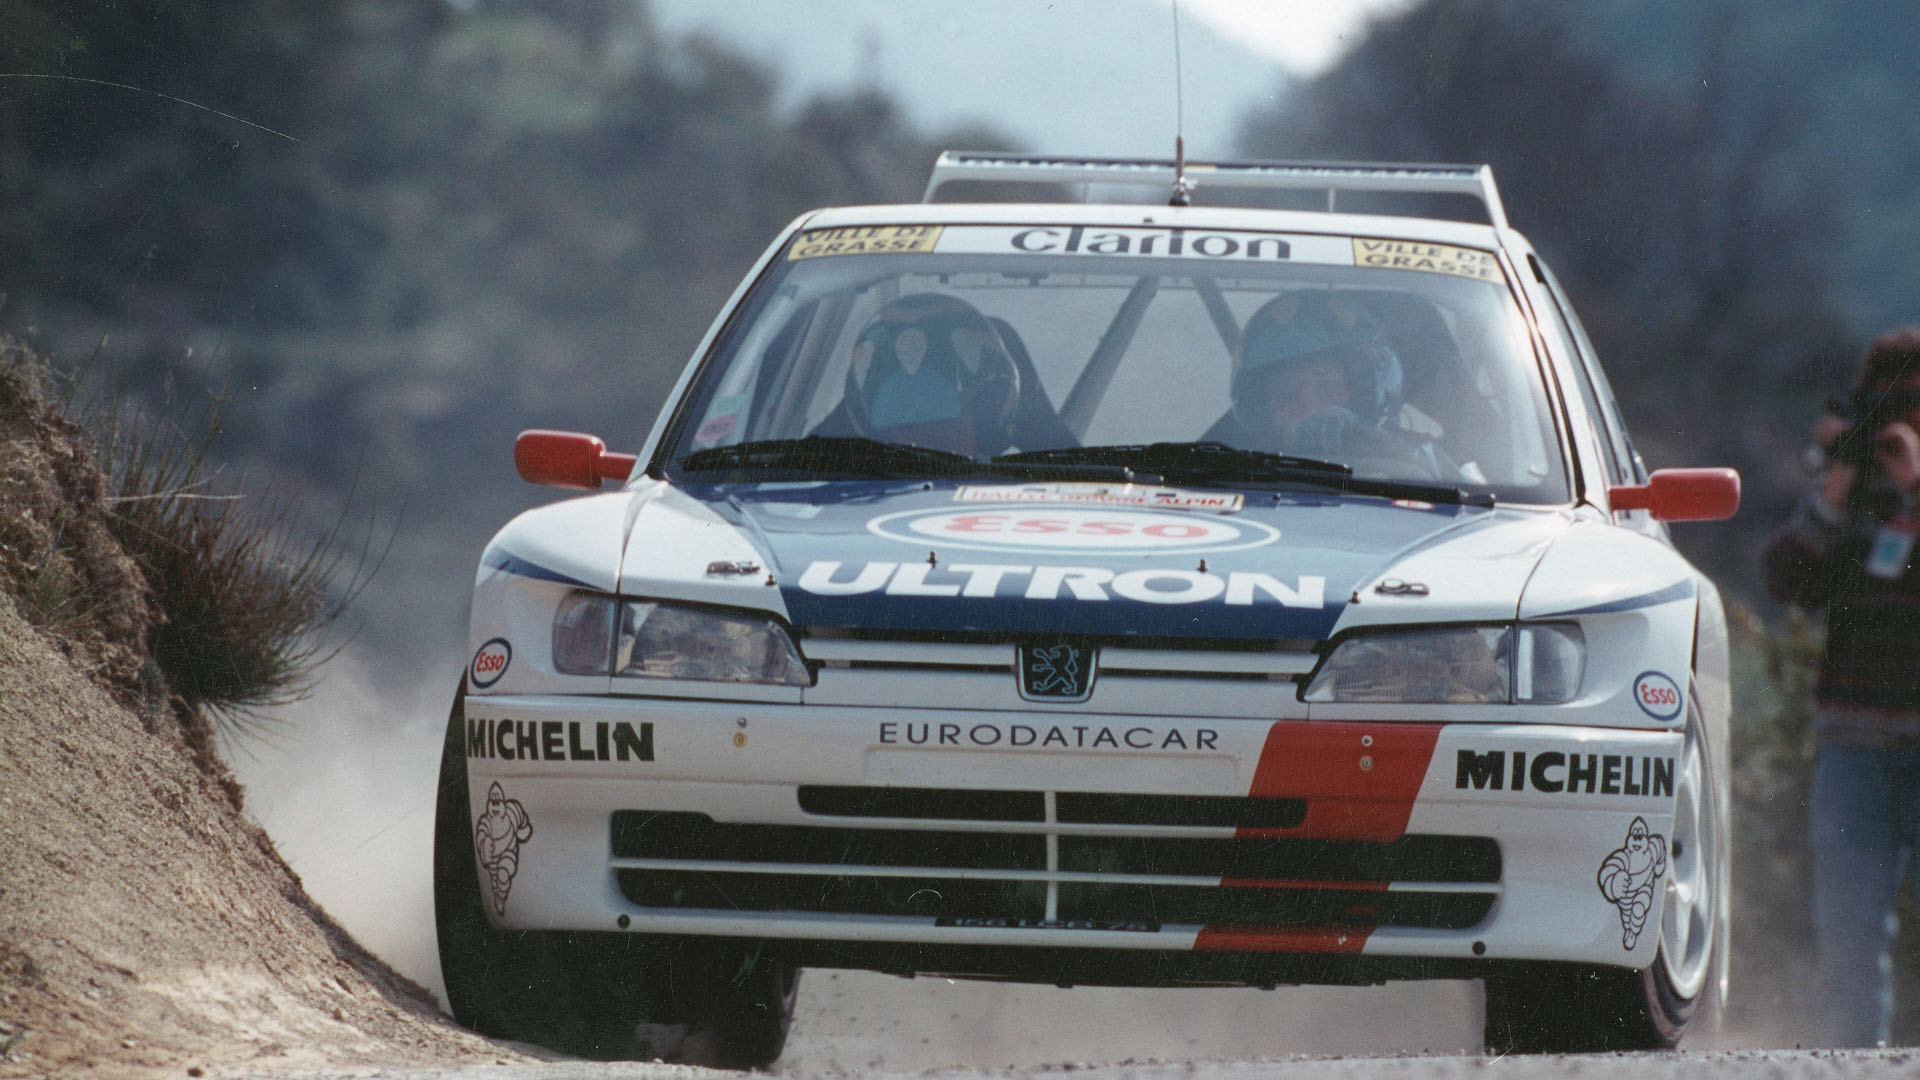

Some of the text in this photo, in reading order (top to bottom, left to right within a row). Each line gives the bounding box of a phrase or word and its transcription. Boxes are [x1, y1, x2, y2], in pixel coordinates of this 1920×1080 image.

[798, 238, 926, 257] GRASSE
[1361, 240, 1493, 264] VILLE DE
[1365, 253, 1492, 277] GRASSE
[798, 561, 1326, 609] ULTRON
[467, 718, 655, 762] MICHELIN
[880, 722, 1219, 751] EURODATACAR
[1456, 749, 1675, 797] MICHELIN
